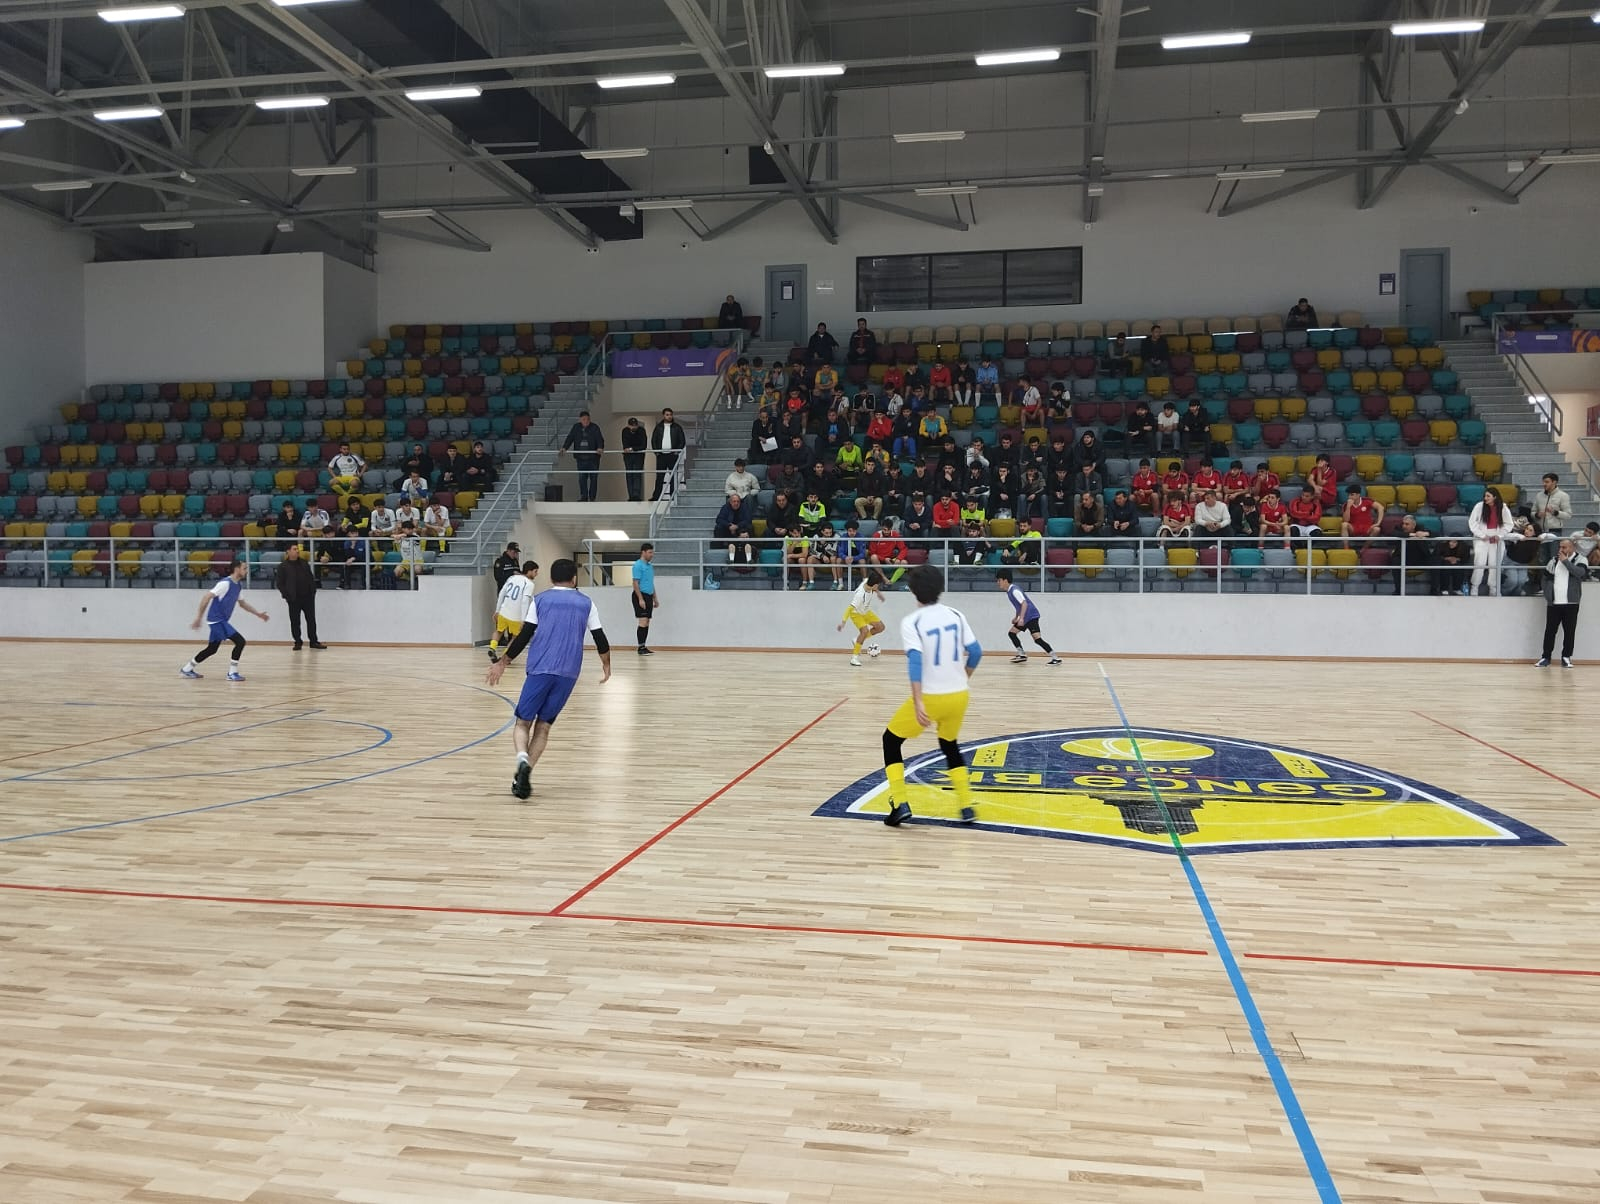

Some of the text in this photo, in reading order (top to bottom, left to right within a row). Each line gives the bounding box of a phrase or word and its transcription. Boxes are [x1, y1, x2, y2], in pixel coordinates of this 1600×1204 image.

[503, 582, 521, 601] 20
[926, 623, 959, 666] 77
[1096, 763, 1192, 775] 2019
